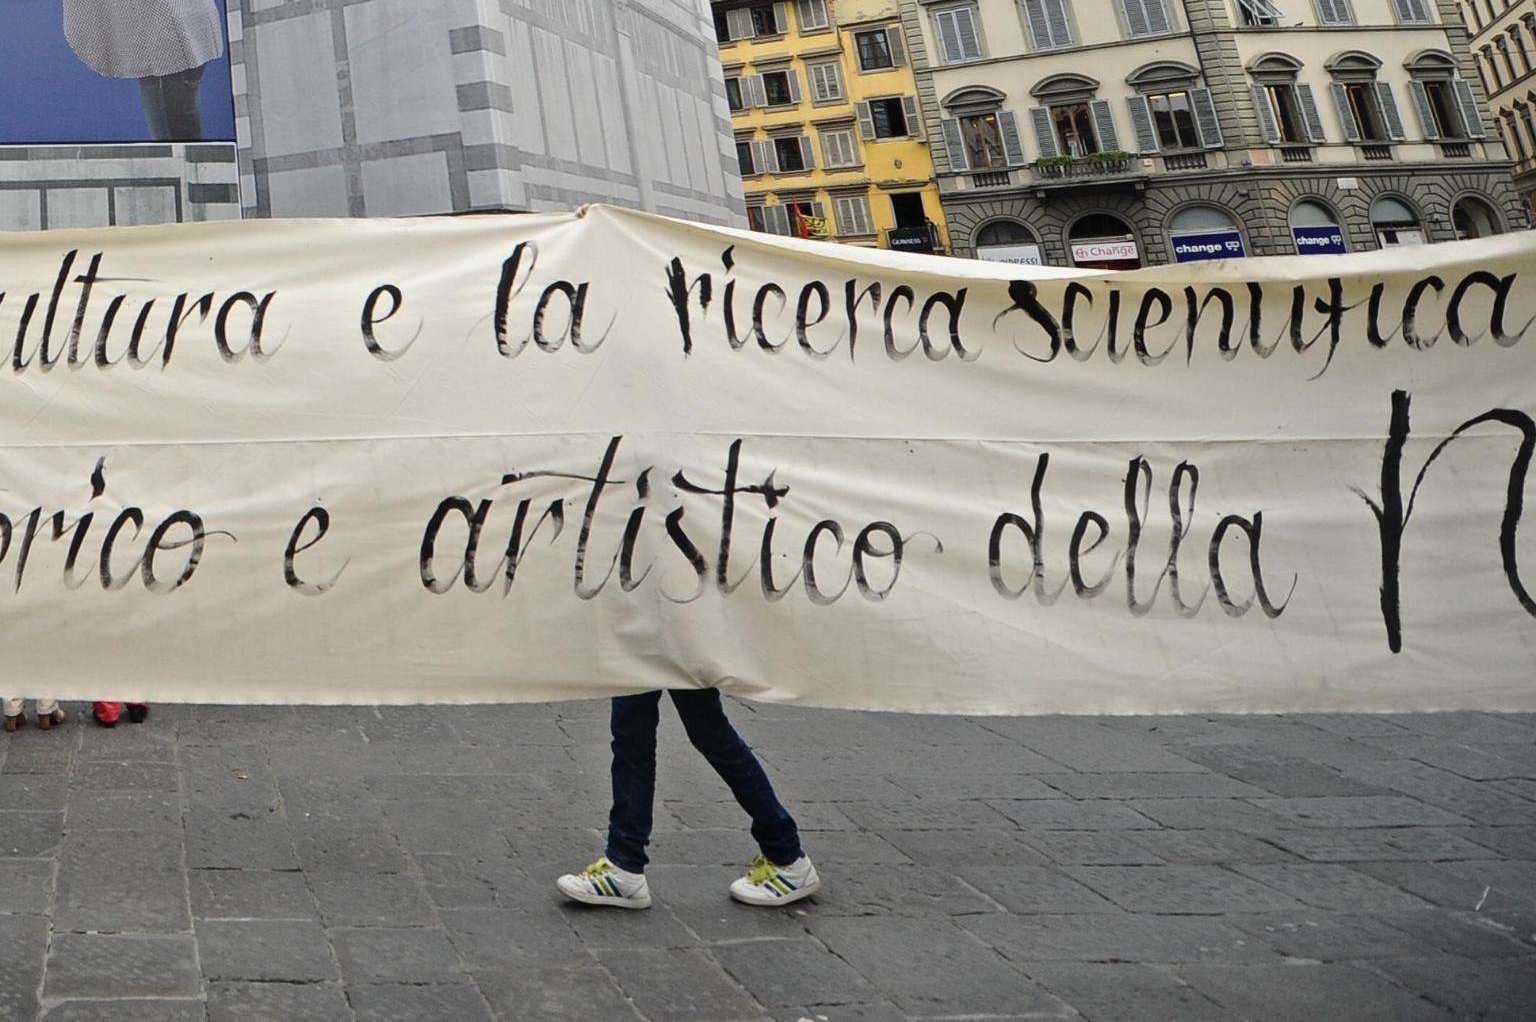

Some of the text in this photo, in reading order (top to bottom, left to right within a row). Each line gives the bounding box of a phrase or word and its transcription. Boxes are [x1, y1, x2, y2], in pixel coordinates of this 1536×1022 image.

[1297, 236, 1330, 246] change
[1090, 245, 1136, 257] Change
[1176, 243, 1222, 254] change
[360, 283, 422, 362] e
[484, 240, 616, 359] la
[664, 244, 982, 362] ricerca
[284, 505, 351, 597] e
[419, 435, 943, 605] artistico
[989, 451, 1298, 620] della
